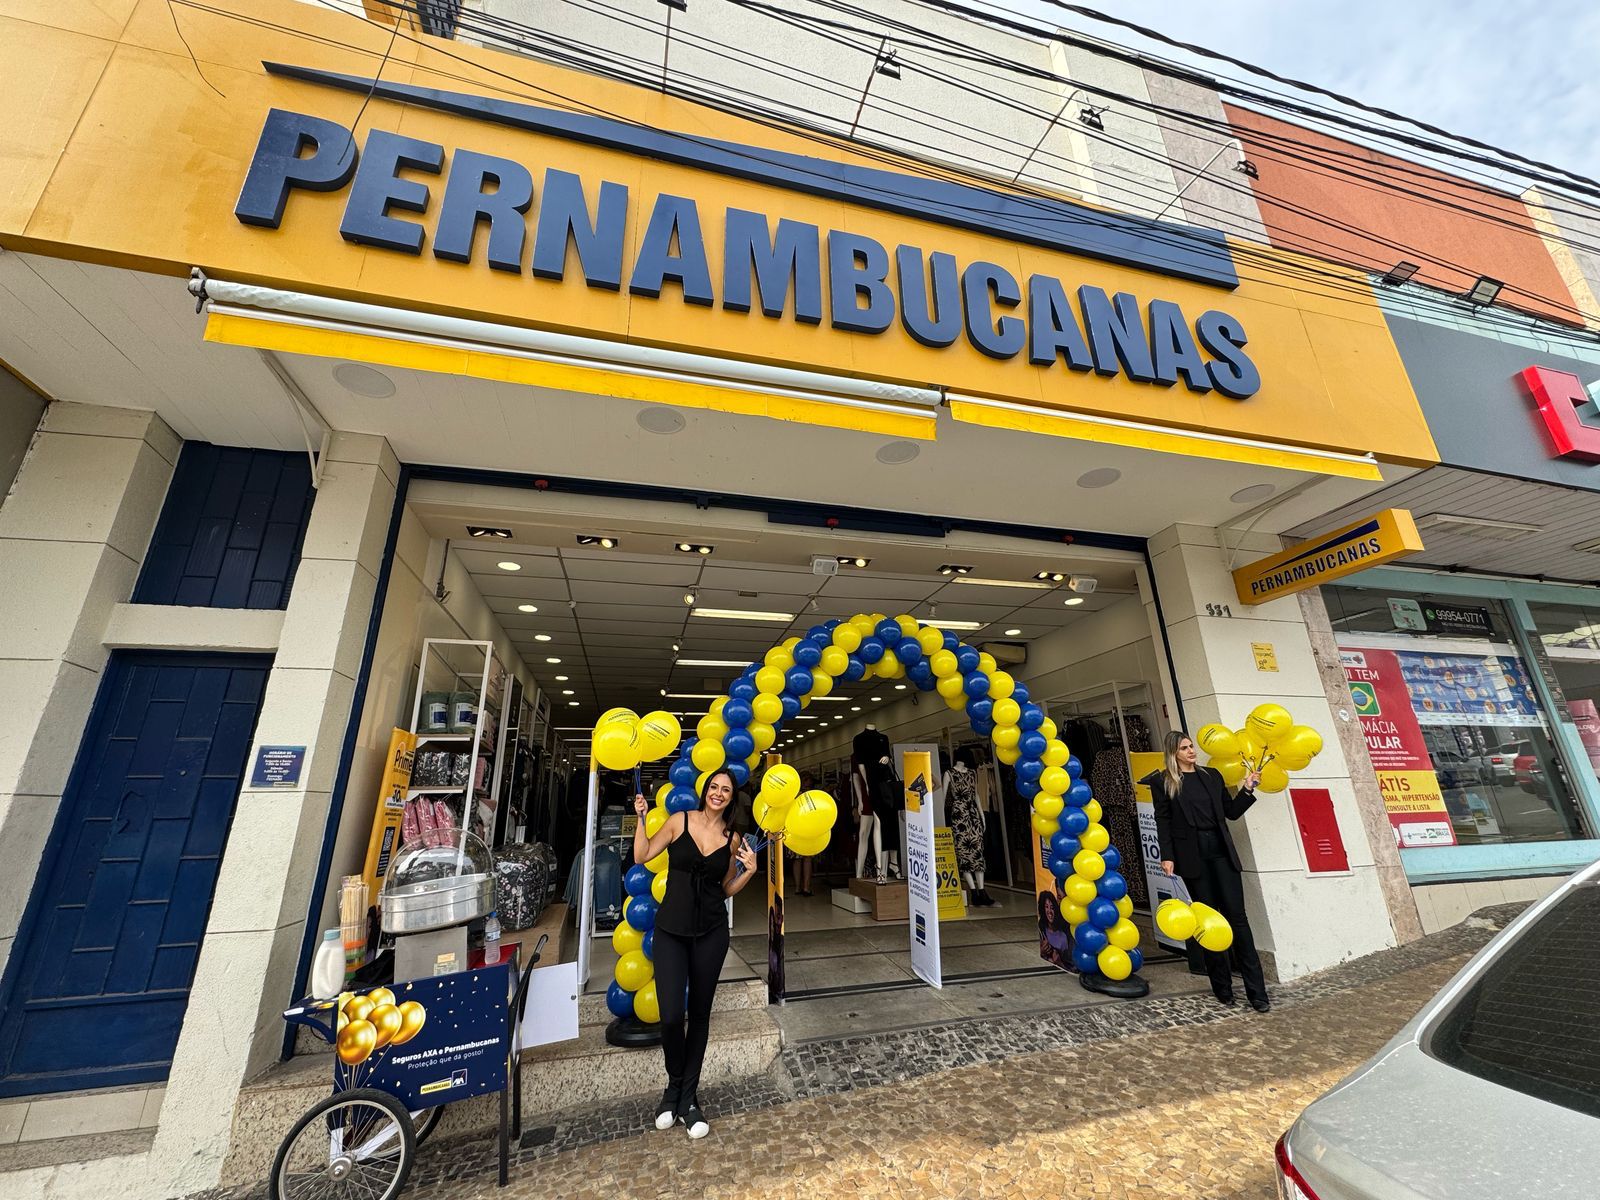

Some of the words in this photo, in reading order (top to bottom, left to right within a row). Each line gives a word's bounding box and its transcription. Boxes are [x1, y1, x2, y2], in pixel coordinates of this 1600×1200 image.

[233, 108, 1260, 398] PERNAMBUCANAS
[1251, 538, 1381, 595] PERNAMBUCANAS
[1436, 610, 1485, 624] 99954-0771
[1355, 669, 1380, 680] TEM
[1380, 774, 1410, 792] ÁTIS
[1402, 793, 1440, 802] HIPERTENSÃO
[1386, 804, 1411, 812] CONSULTE
[908, 847, 928, 862] GANHE
[908, 858, 929, 882] 10%
[392, 1053, 422, 1064] Seguros
[422, 1049, 438, 1058] AXA
[444, 1038, 500, 1054] Pernambucanas
[408, 1058, 438, 1070] Proteção
[440, 1056, 452, 1064] que
[464, 1049, 484, 1060] gosto!
